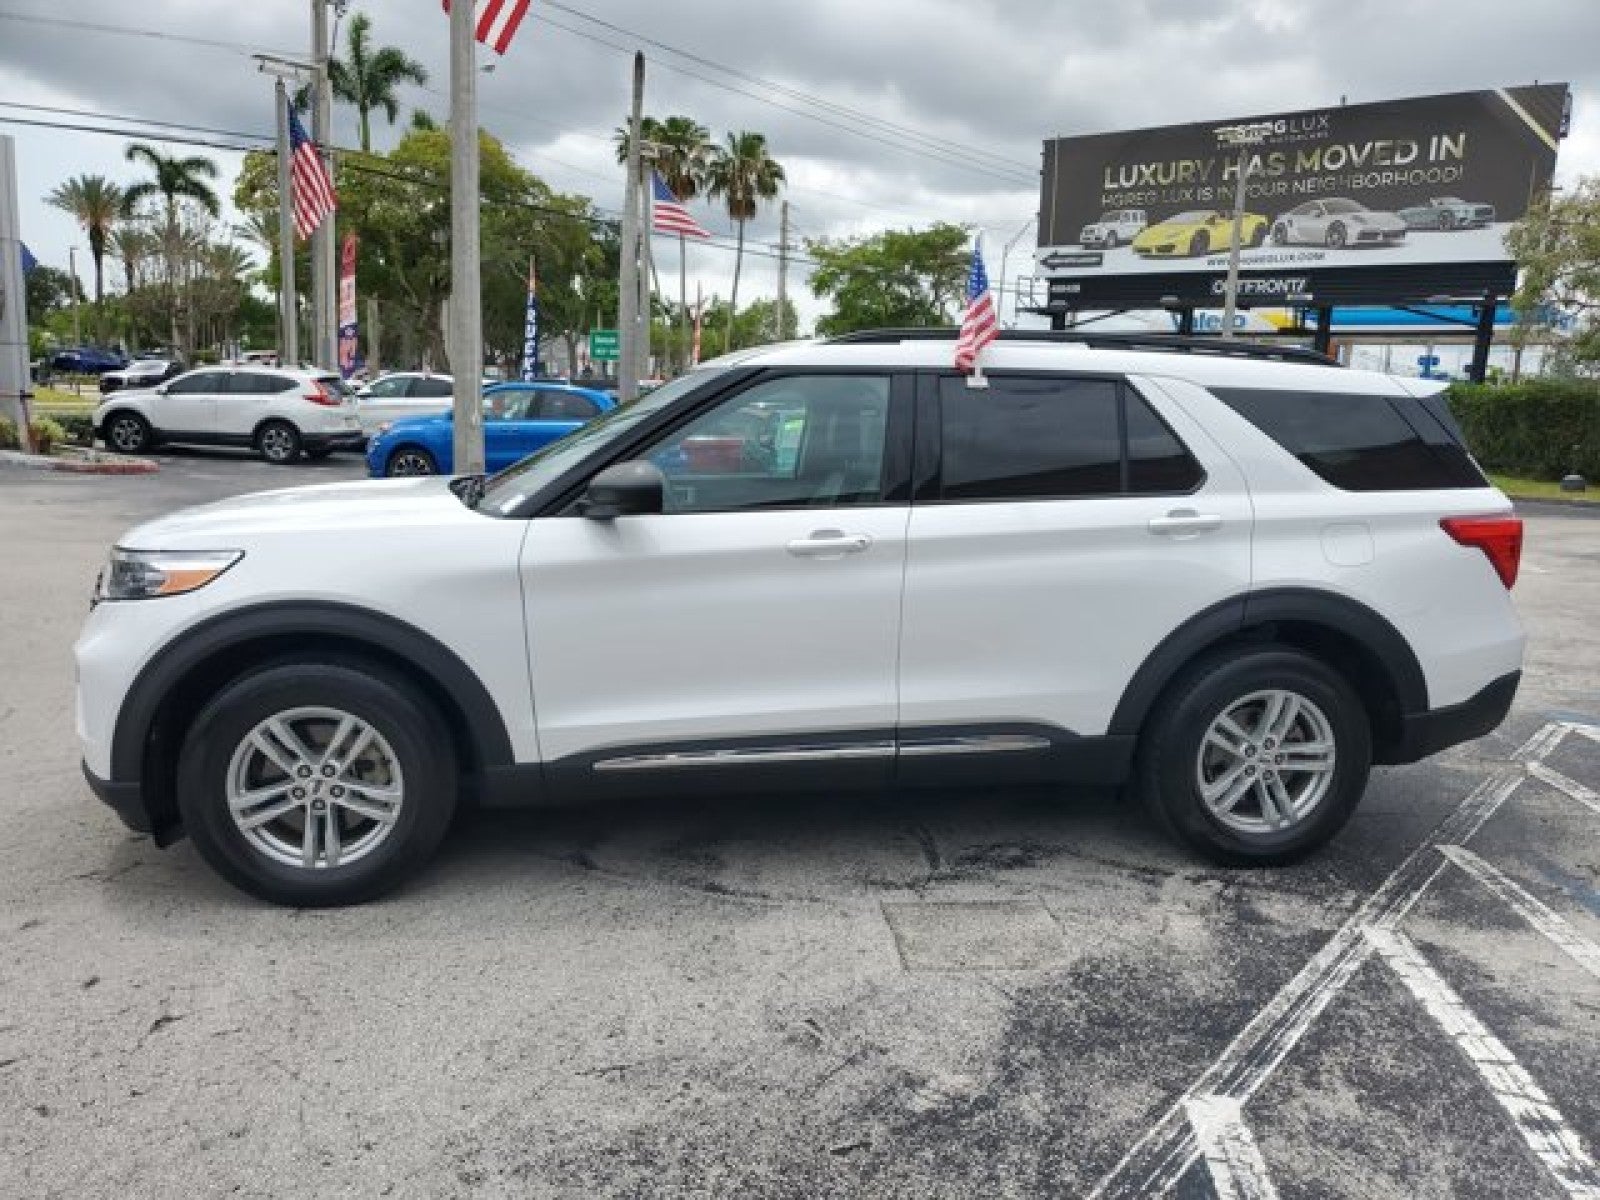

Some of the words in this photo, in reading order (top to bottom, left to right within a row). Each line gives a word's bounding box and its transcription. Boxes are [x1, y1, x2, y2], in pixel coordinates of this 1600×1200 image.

[1104, 160, 1215, 190] LUXURY
[1222, 152, 1286, 181] HAS
[1295, 140, 1419, 173] MOVED
[1429, 132, 1466, 161] IN
[1197, 186, 1213, 201] IS
